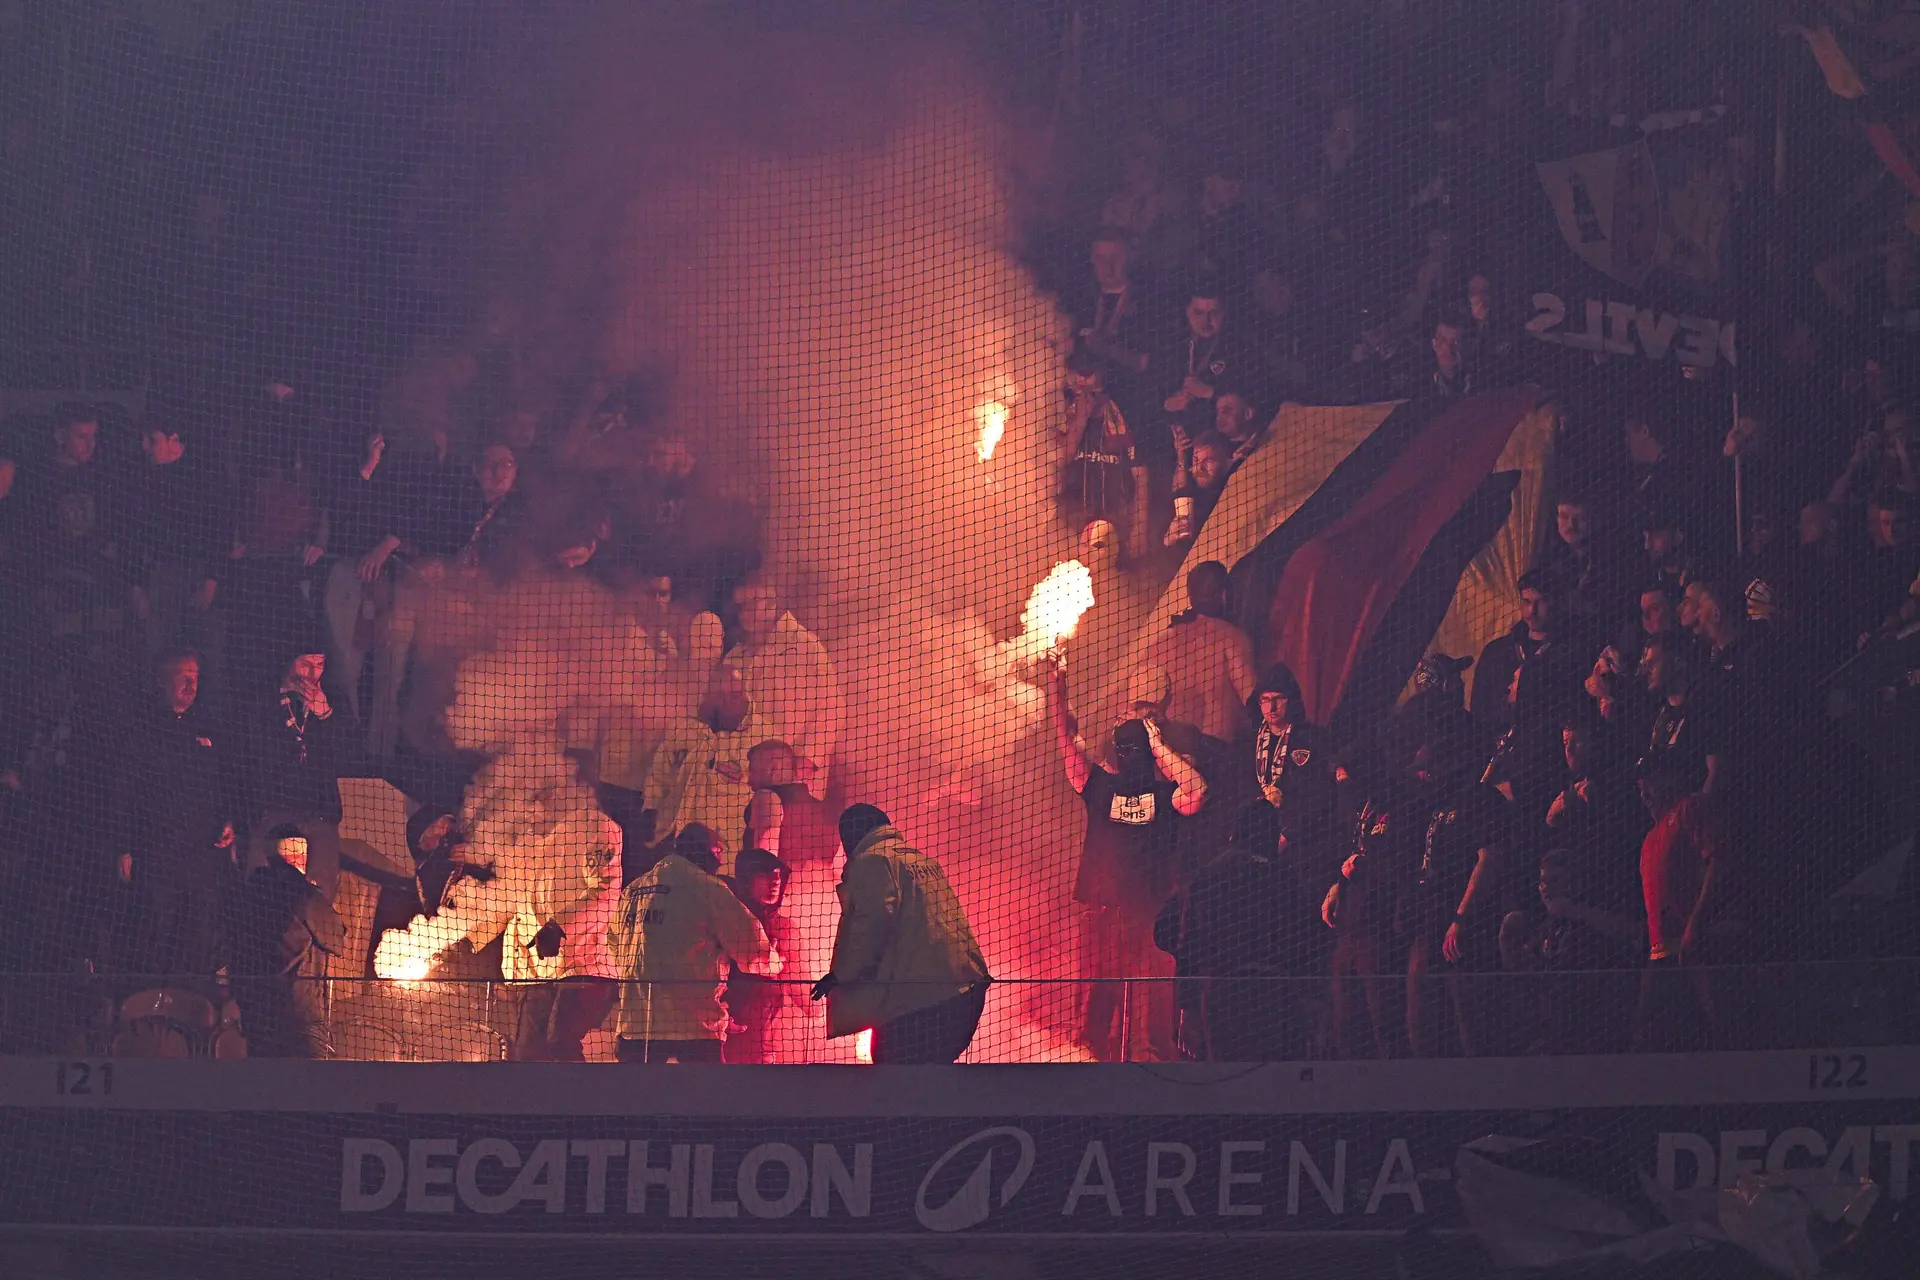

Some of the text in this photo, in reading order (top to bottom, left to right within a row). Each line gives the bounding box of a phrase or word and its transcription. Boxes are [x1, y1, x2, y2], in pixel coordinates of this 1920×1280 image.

[56, 1062, 114, 1095] 121
[1809, 1054, 1868, 1090] 122
[340, 1136, 1426, 1220] DECATHLON ARENA
